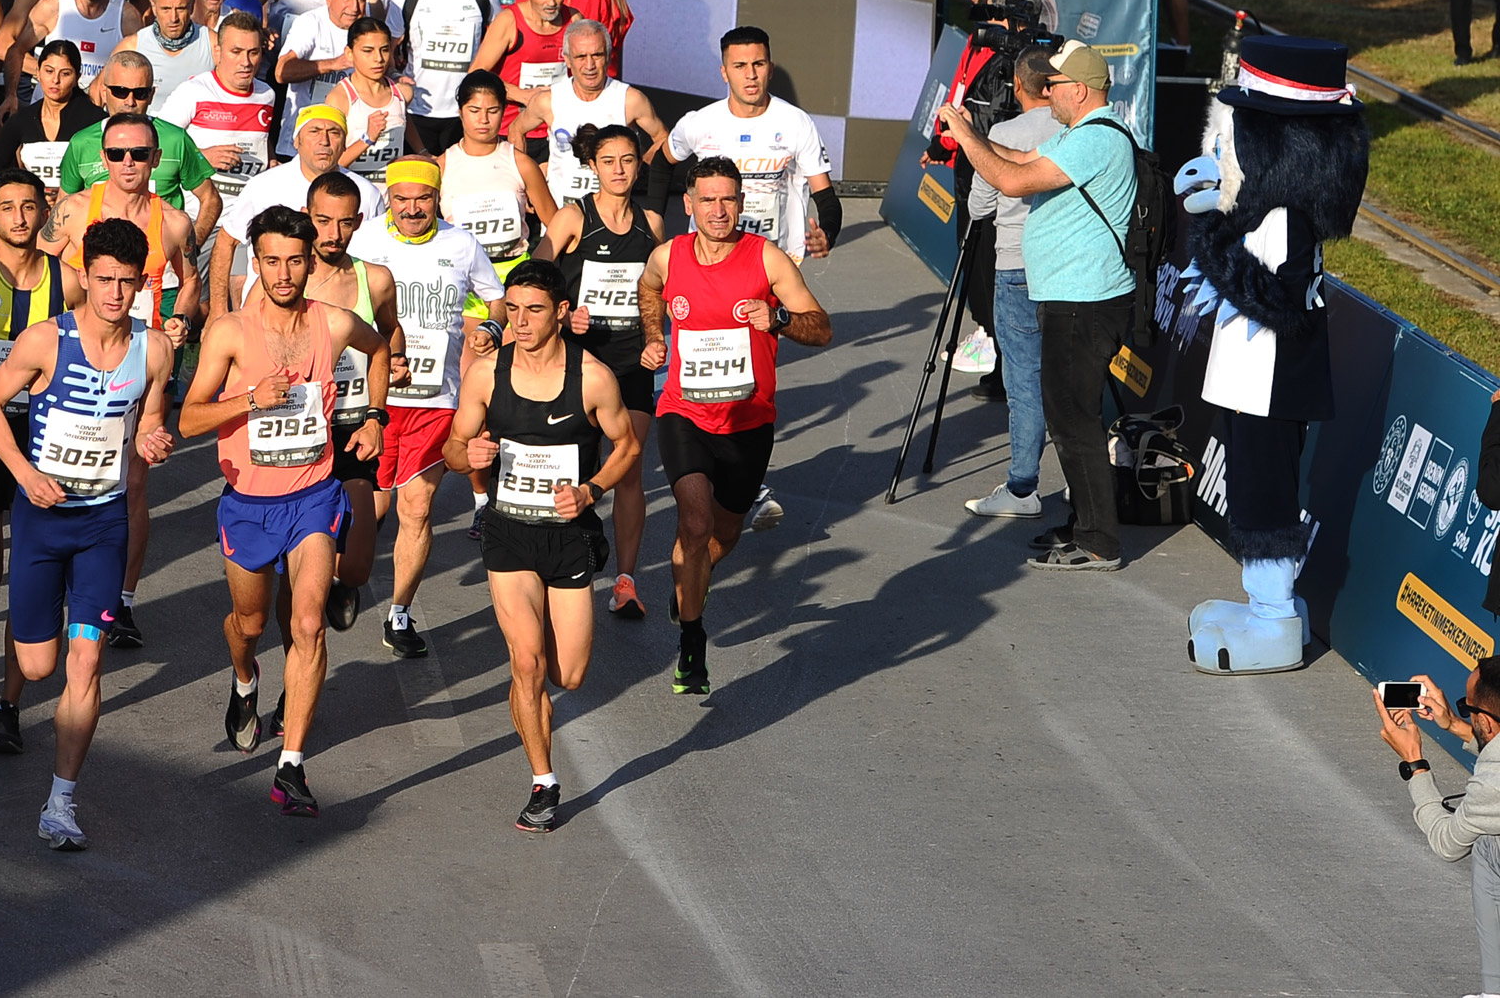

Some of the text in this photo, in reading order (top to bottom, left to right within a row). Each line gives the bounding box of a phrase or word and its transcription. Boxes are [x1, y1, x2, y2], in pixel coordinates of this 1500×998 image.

[426, 40, 468, 54] 3470
[736, 217, 774, 234] 443
[583, 289, 634, 306] 2422
[683, 357, 746, 377] 3244
[336, 377, 365, 398] 99
[257, 416, 317, 438] 2192
[63, 432, 108, 442] MARATONU
[45, 442, 118, 468] 3052
[516, 462, 561, 470] MARATONU
